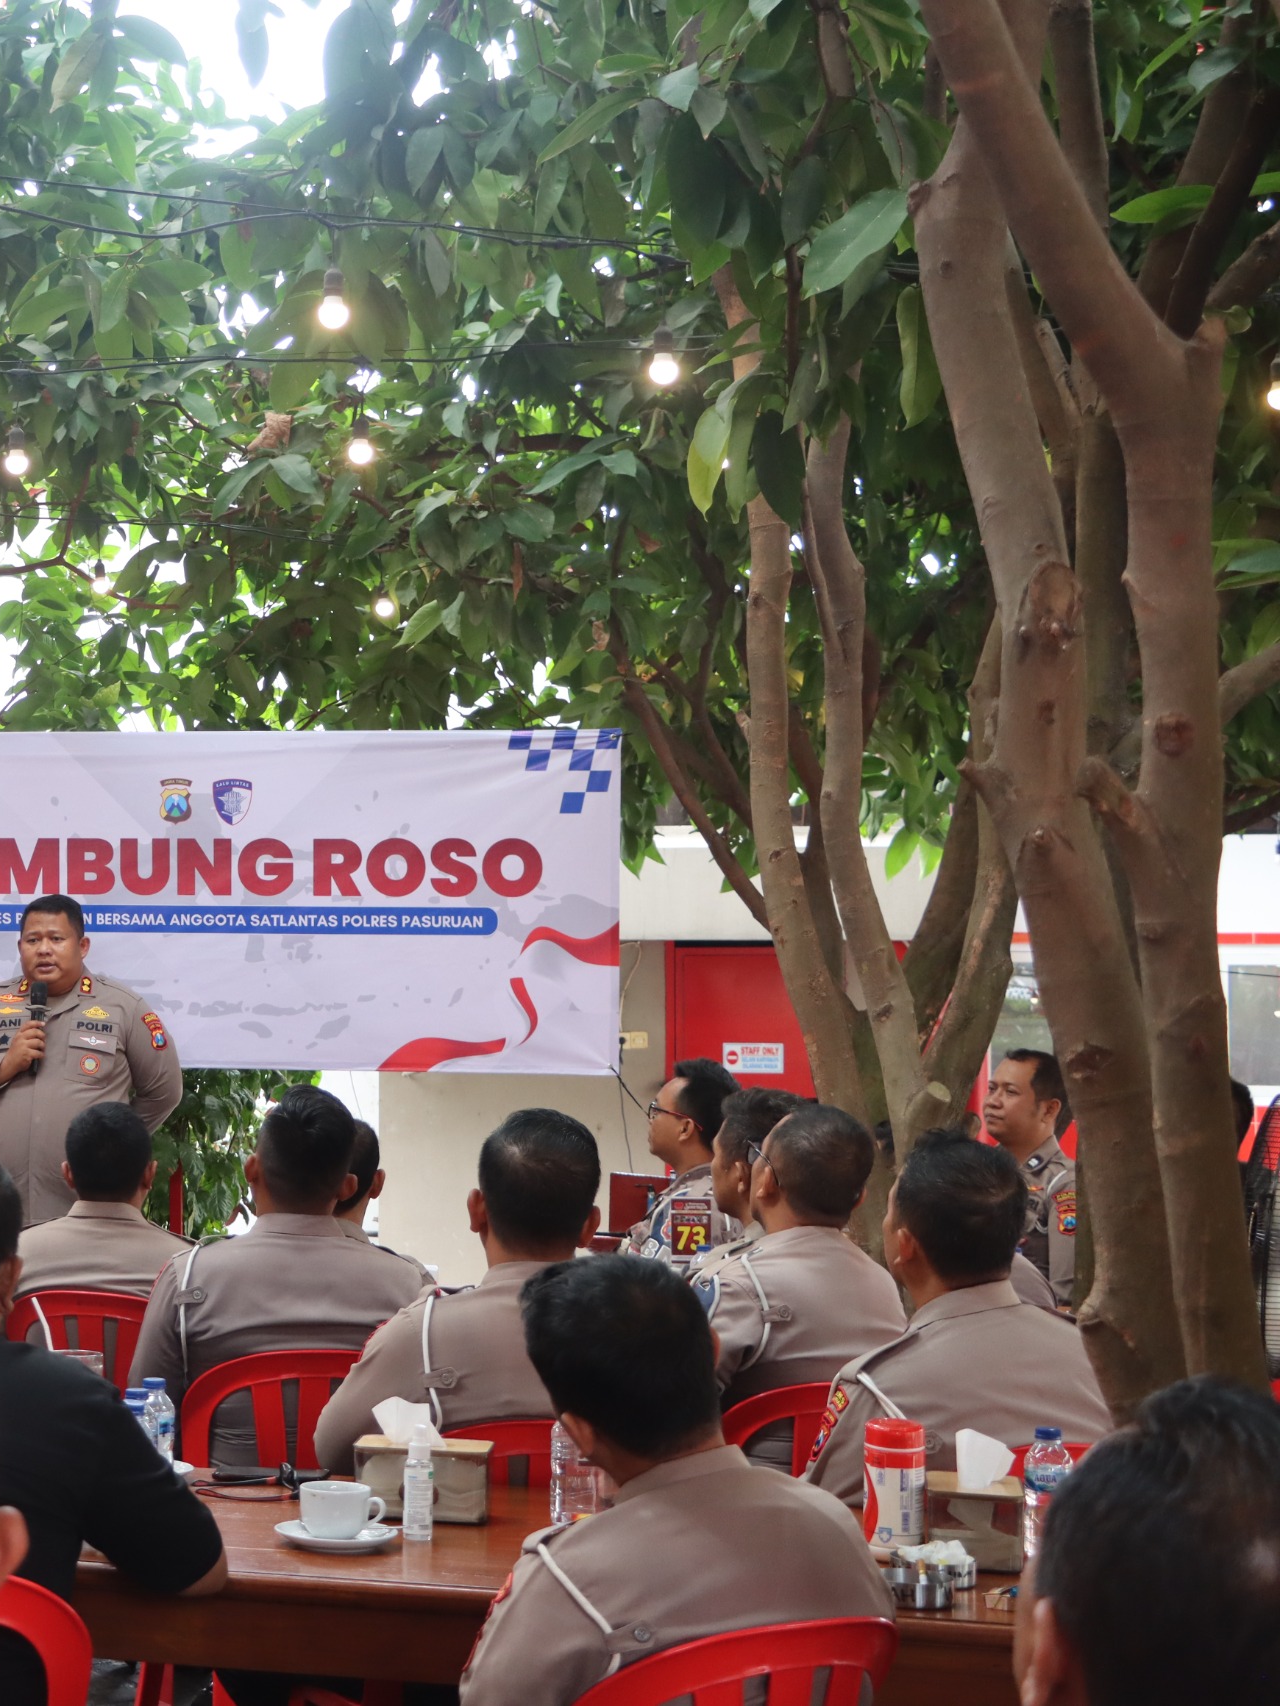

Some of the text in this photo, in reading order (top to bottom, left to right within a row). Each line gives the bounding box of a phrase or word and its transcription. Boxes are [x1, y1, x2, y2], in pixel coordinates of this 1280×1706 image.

[313, 837, 543, 898] ROSO
[96, 912, 166, 926] BERSAMA
[170, 913, 247, 927] ANGGOTA
[250, 914, 338, 928] SATLANTAS
[342, 915, 398, 928] POLRES
[402, 915, 484, 929] PASURUAN
[77, 1021, 113, 1033] POLRI
[741, 1046, 780, 1056] STAFF ONLY
[677, 1225, 706, 1251] 73
[1034, 1474, 1057, 1483] AQUA
